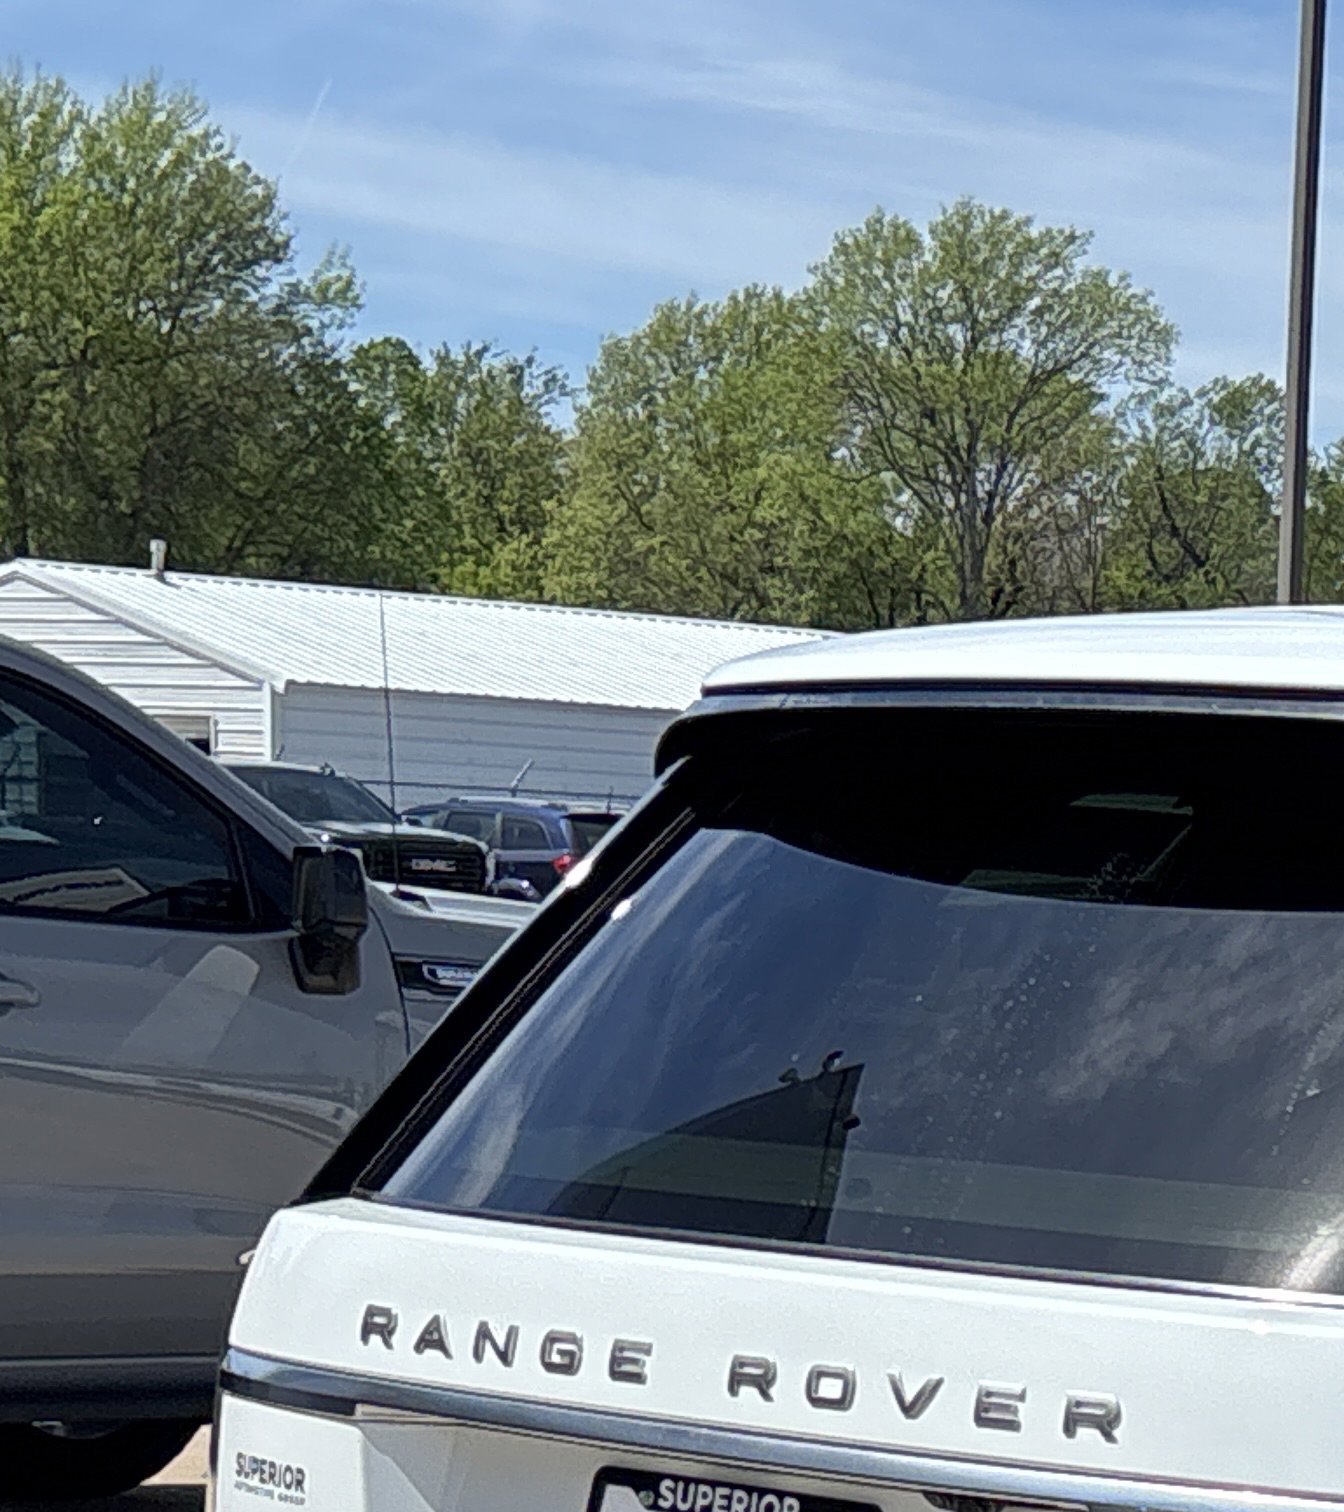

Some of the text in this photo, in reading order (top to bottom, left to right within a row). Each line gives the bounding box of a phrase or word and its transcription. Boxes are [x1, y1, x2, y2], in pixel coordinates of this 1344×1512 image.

[361, 1303, 1123, 1444] RANGE ROVER
[235, 1451, 306, 1494] SUPERIOR
